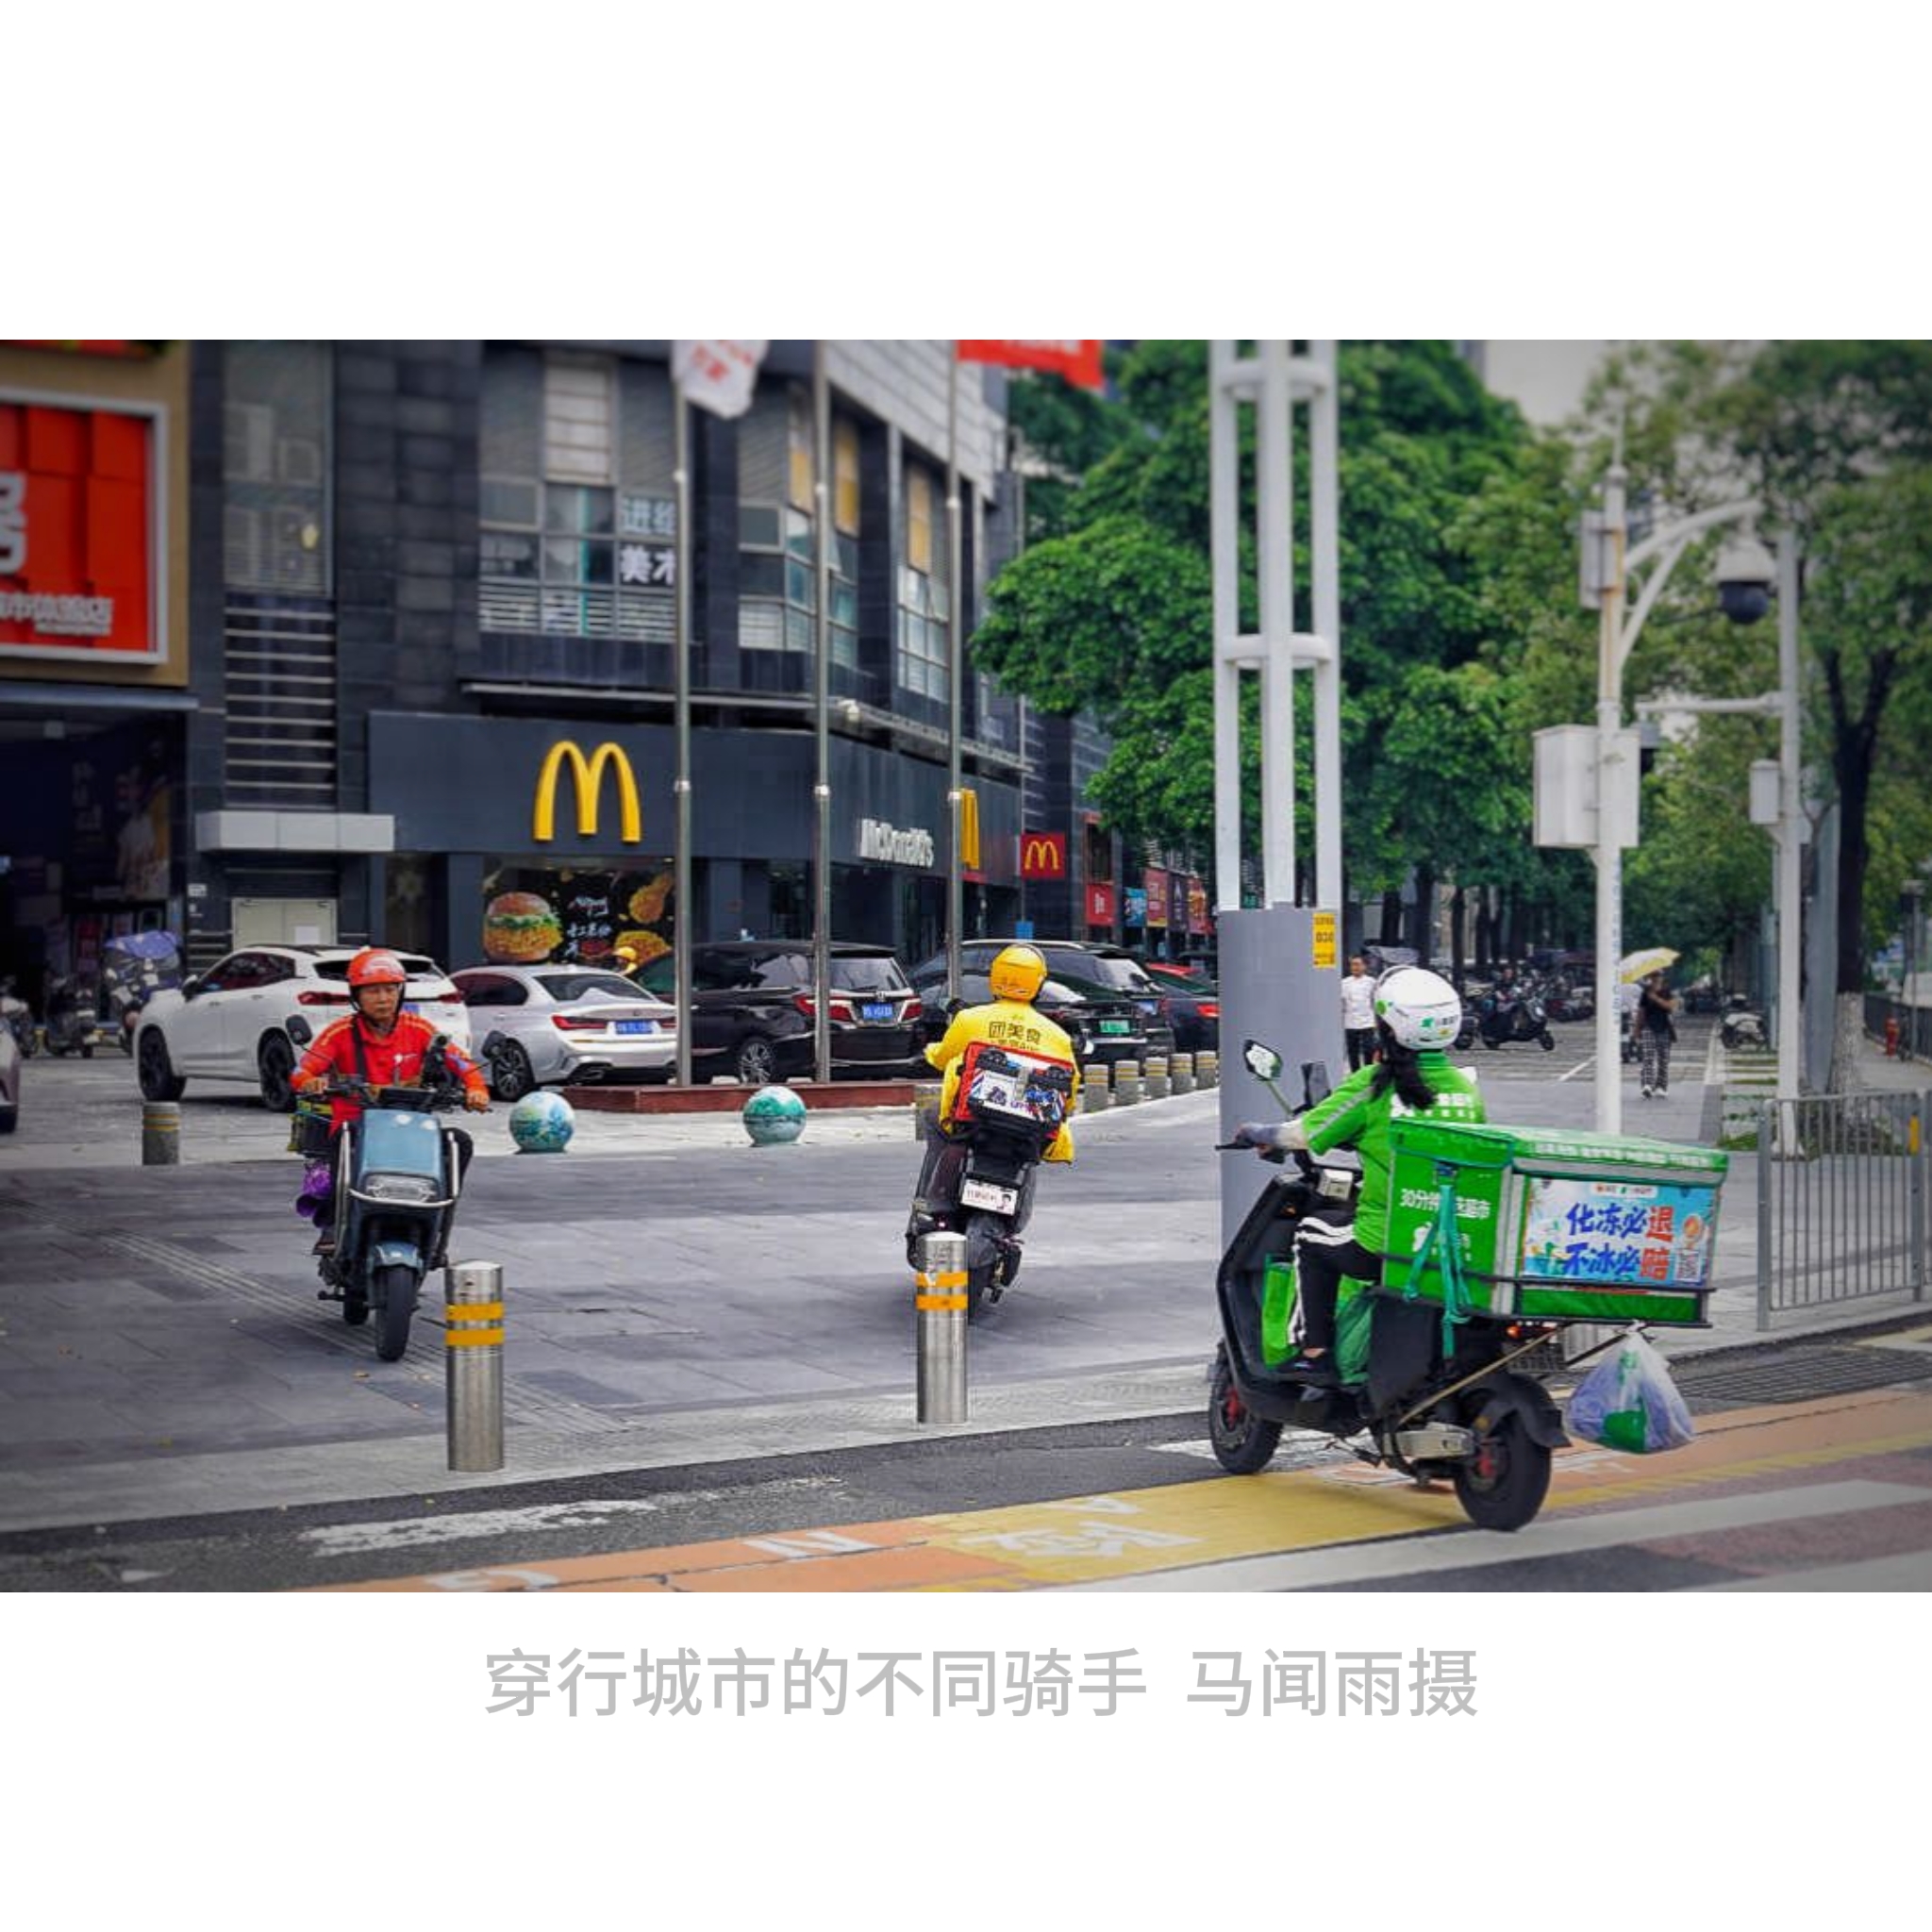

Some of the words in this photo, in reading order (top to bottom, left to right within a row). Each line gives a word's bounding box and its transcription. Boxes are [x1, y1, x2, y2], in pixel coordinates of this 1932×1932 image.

[1566, 1203, 1674, 1242] 化冻必退
[1563, 1242, 1671, 1280] 不冰必赔
